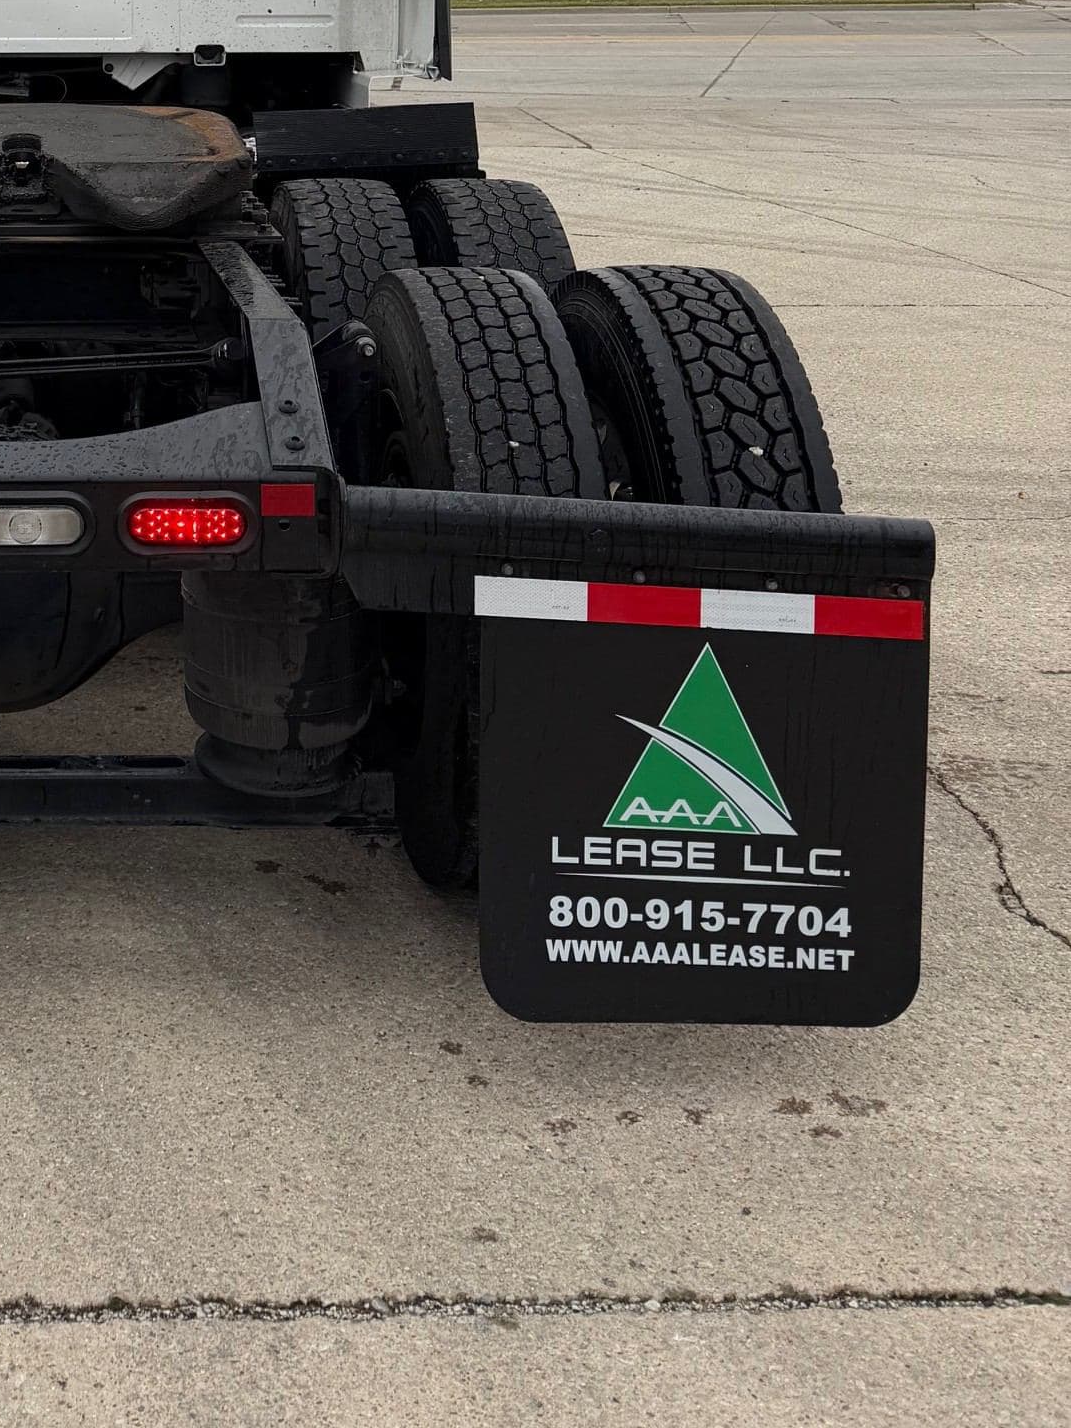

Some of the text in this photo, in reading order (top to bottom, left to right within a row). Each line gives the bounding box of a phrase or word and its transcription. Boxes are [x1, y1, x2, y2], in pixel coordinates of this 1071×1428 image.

[620, 796, 742, 828] AAA
[551, 836, 852, 877] LEASE LLC.
[548, 895, 853, 939] 800-915-7704
[545, 938, 856, 972] WWW.AAALEASE.NET
